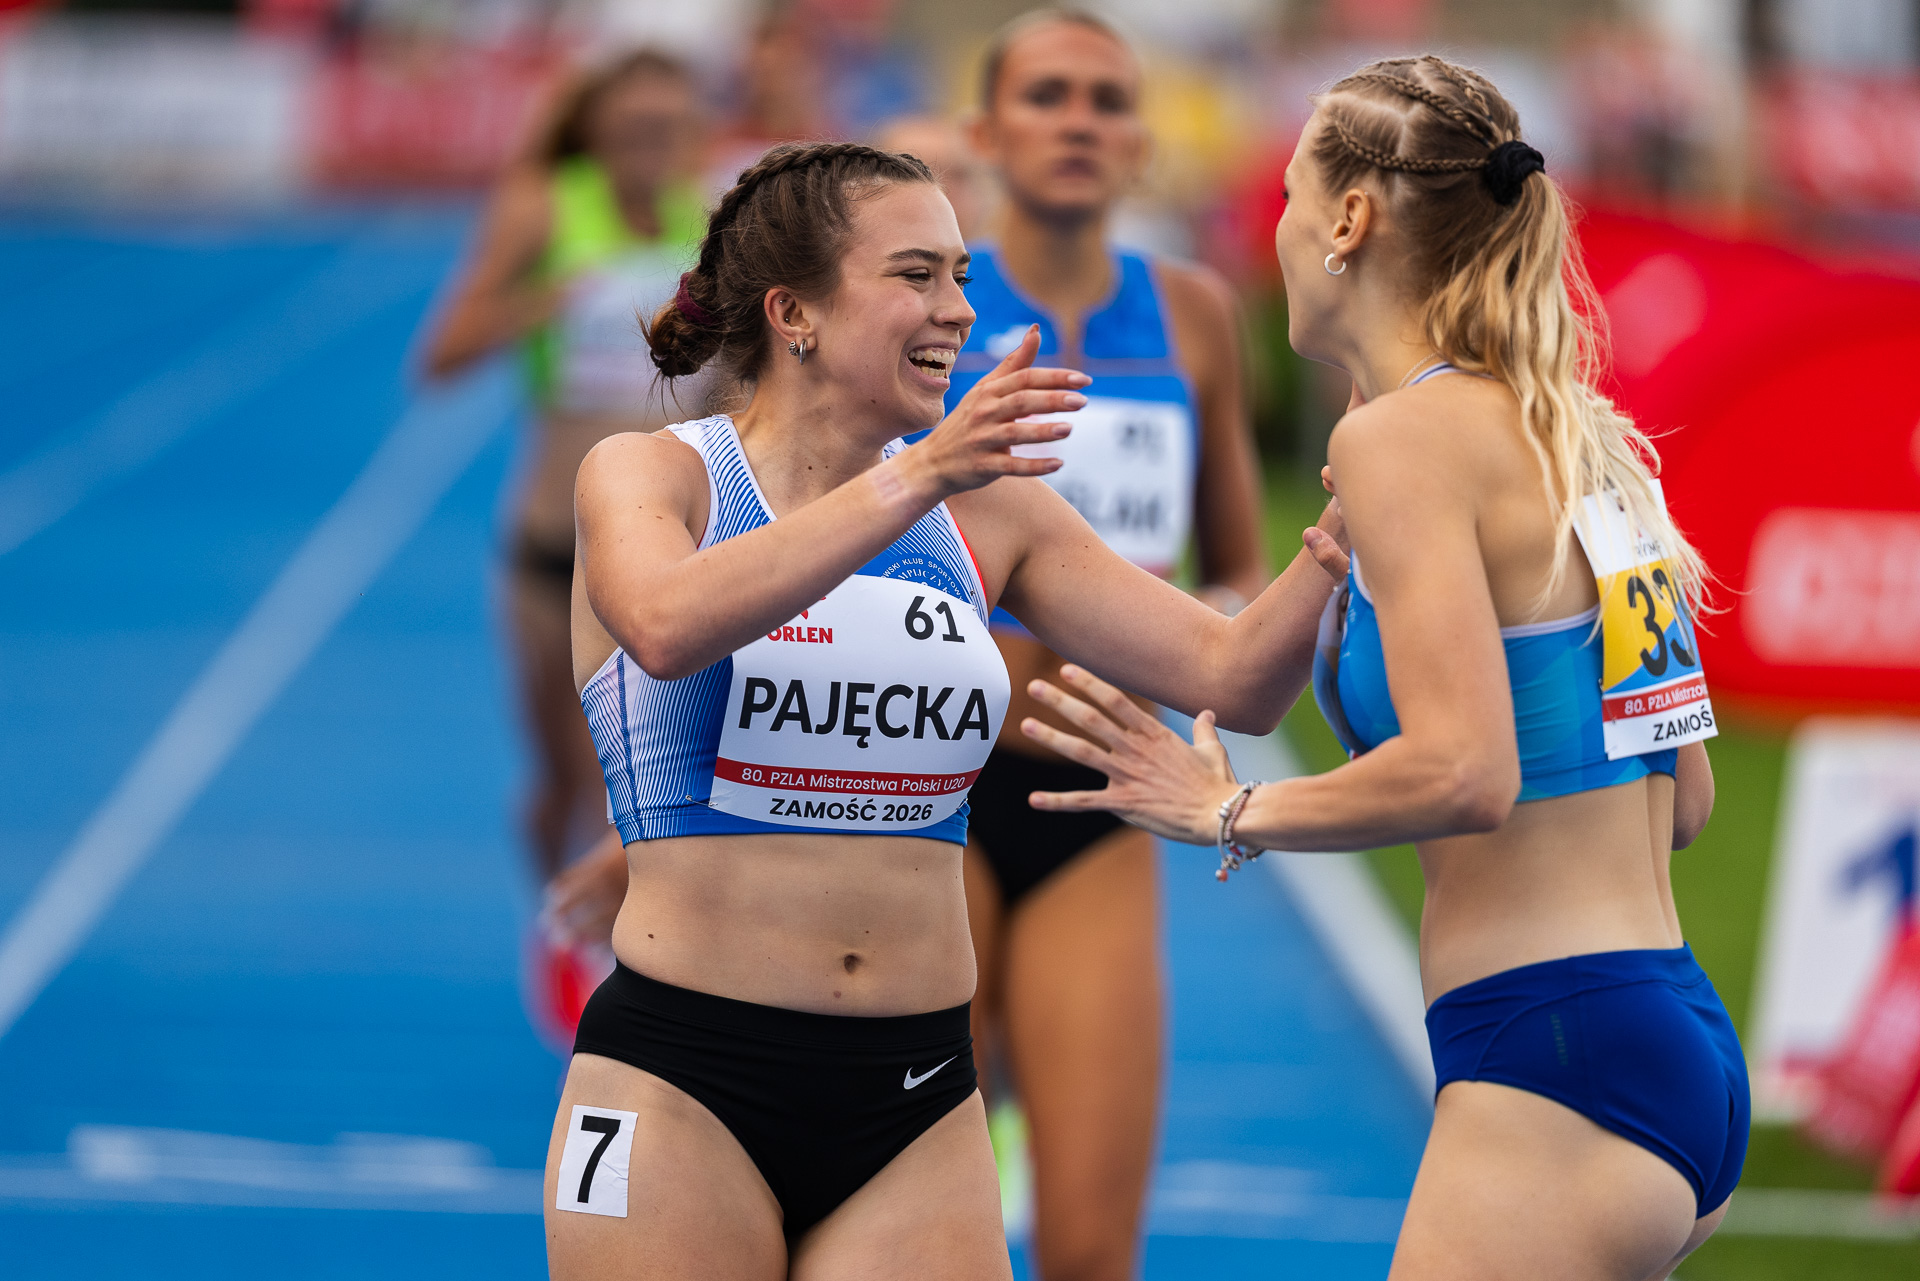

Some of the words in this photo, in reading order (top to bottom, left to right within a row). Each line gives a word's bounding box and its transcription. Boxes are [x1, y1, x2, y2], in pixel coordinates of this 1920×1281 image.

[902, 557, 924, 566] KLUB
[904, 595, 966, 643] 61
[767, 626, 833, 644] ORLEN
[738, 677, 990, 749] PAJĘCKA
[1624, 698, 1646, 716] 80.
[1647, 692, 1672, 711] PZLA
[1653, 704, 1713, 742] ZAMOŚ
[741, 767, 766, 784] 80.
[770, 771, 806, 787] PZLA
[809, 774, 898, 792] Mistrzostwa
[901, 778, 941, 793] Polski
[943, 776, 966, 792] U20
[769, 797, 878, 822] ZAMOŚĆ
[882, 803, 933, 822] 2026
[577, 1114, 622, 1204] 7
